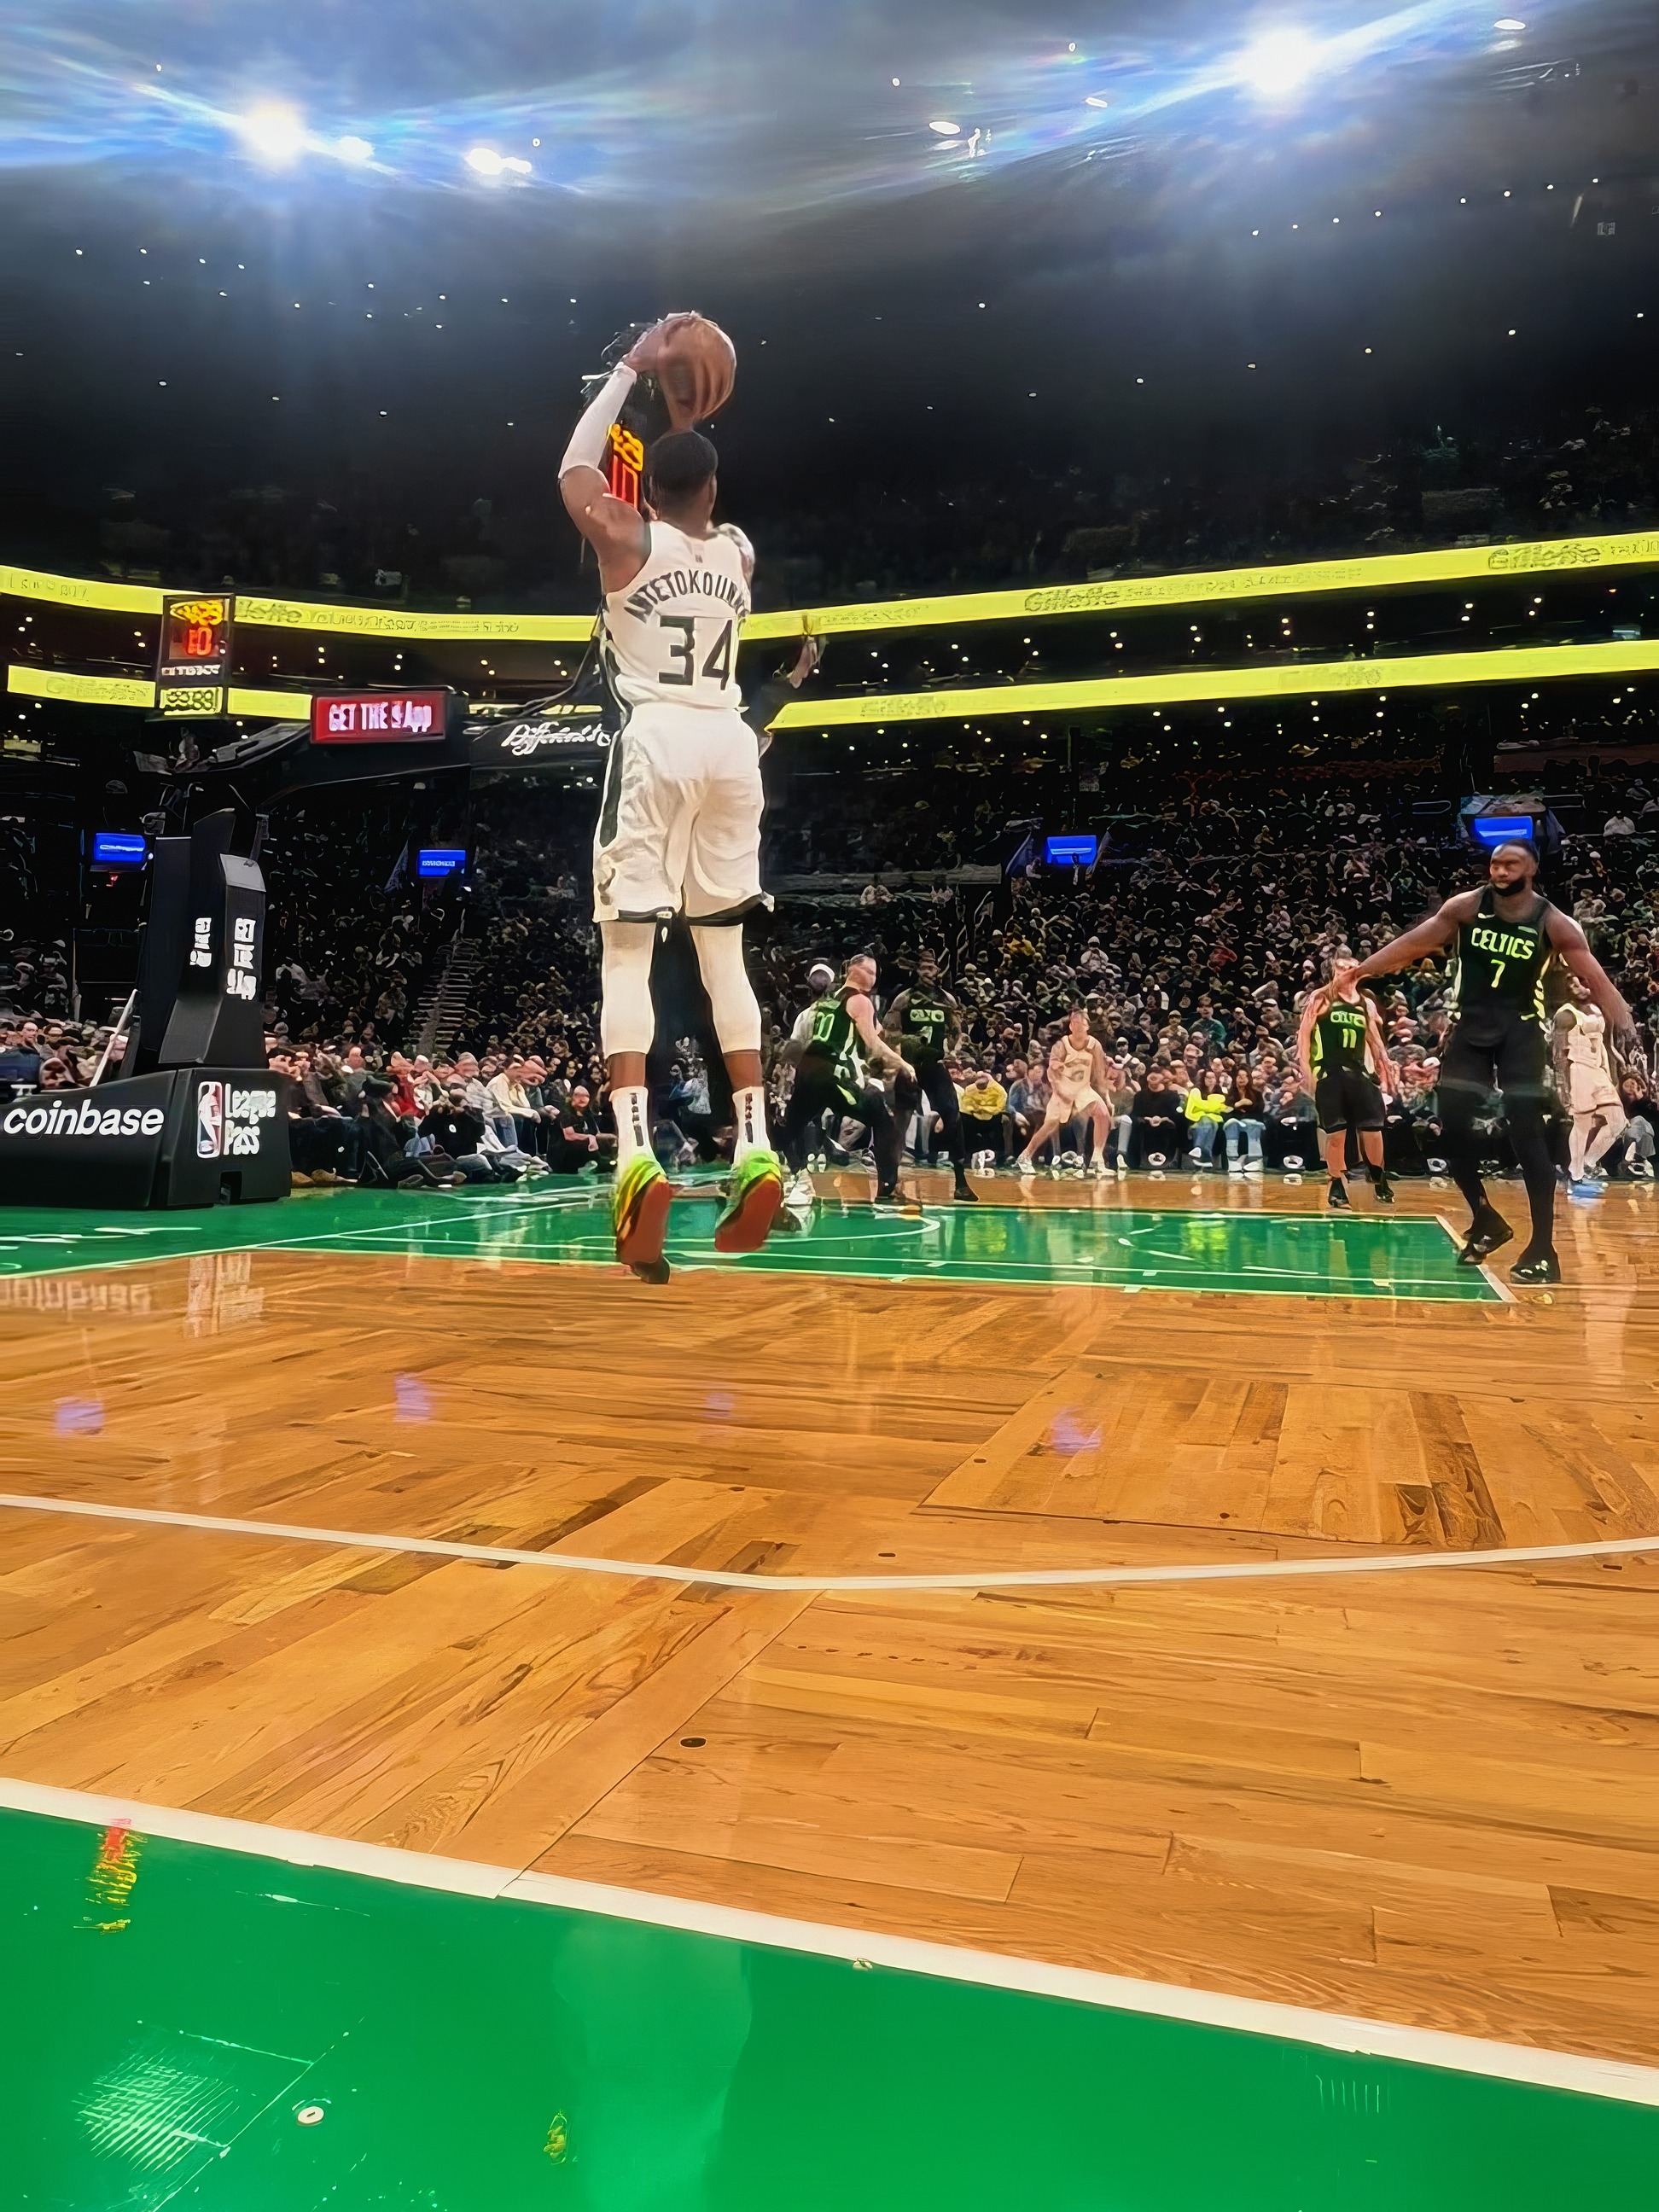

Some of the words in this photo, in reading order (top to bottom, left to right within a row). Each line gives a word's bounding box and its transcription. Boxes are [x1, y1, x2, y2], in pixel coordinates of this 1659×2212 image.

[658, 615, 733, 691] 34
[1471, 928, 1535, 960] CELTICS
[1490, 958, 1506, 988] 7
[1342, 1027, 1357, 1049] 11
[3, 1098, 165, 1136] coinbase
